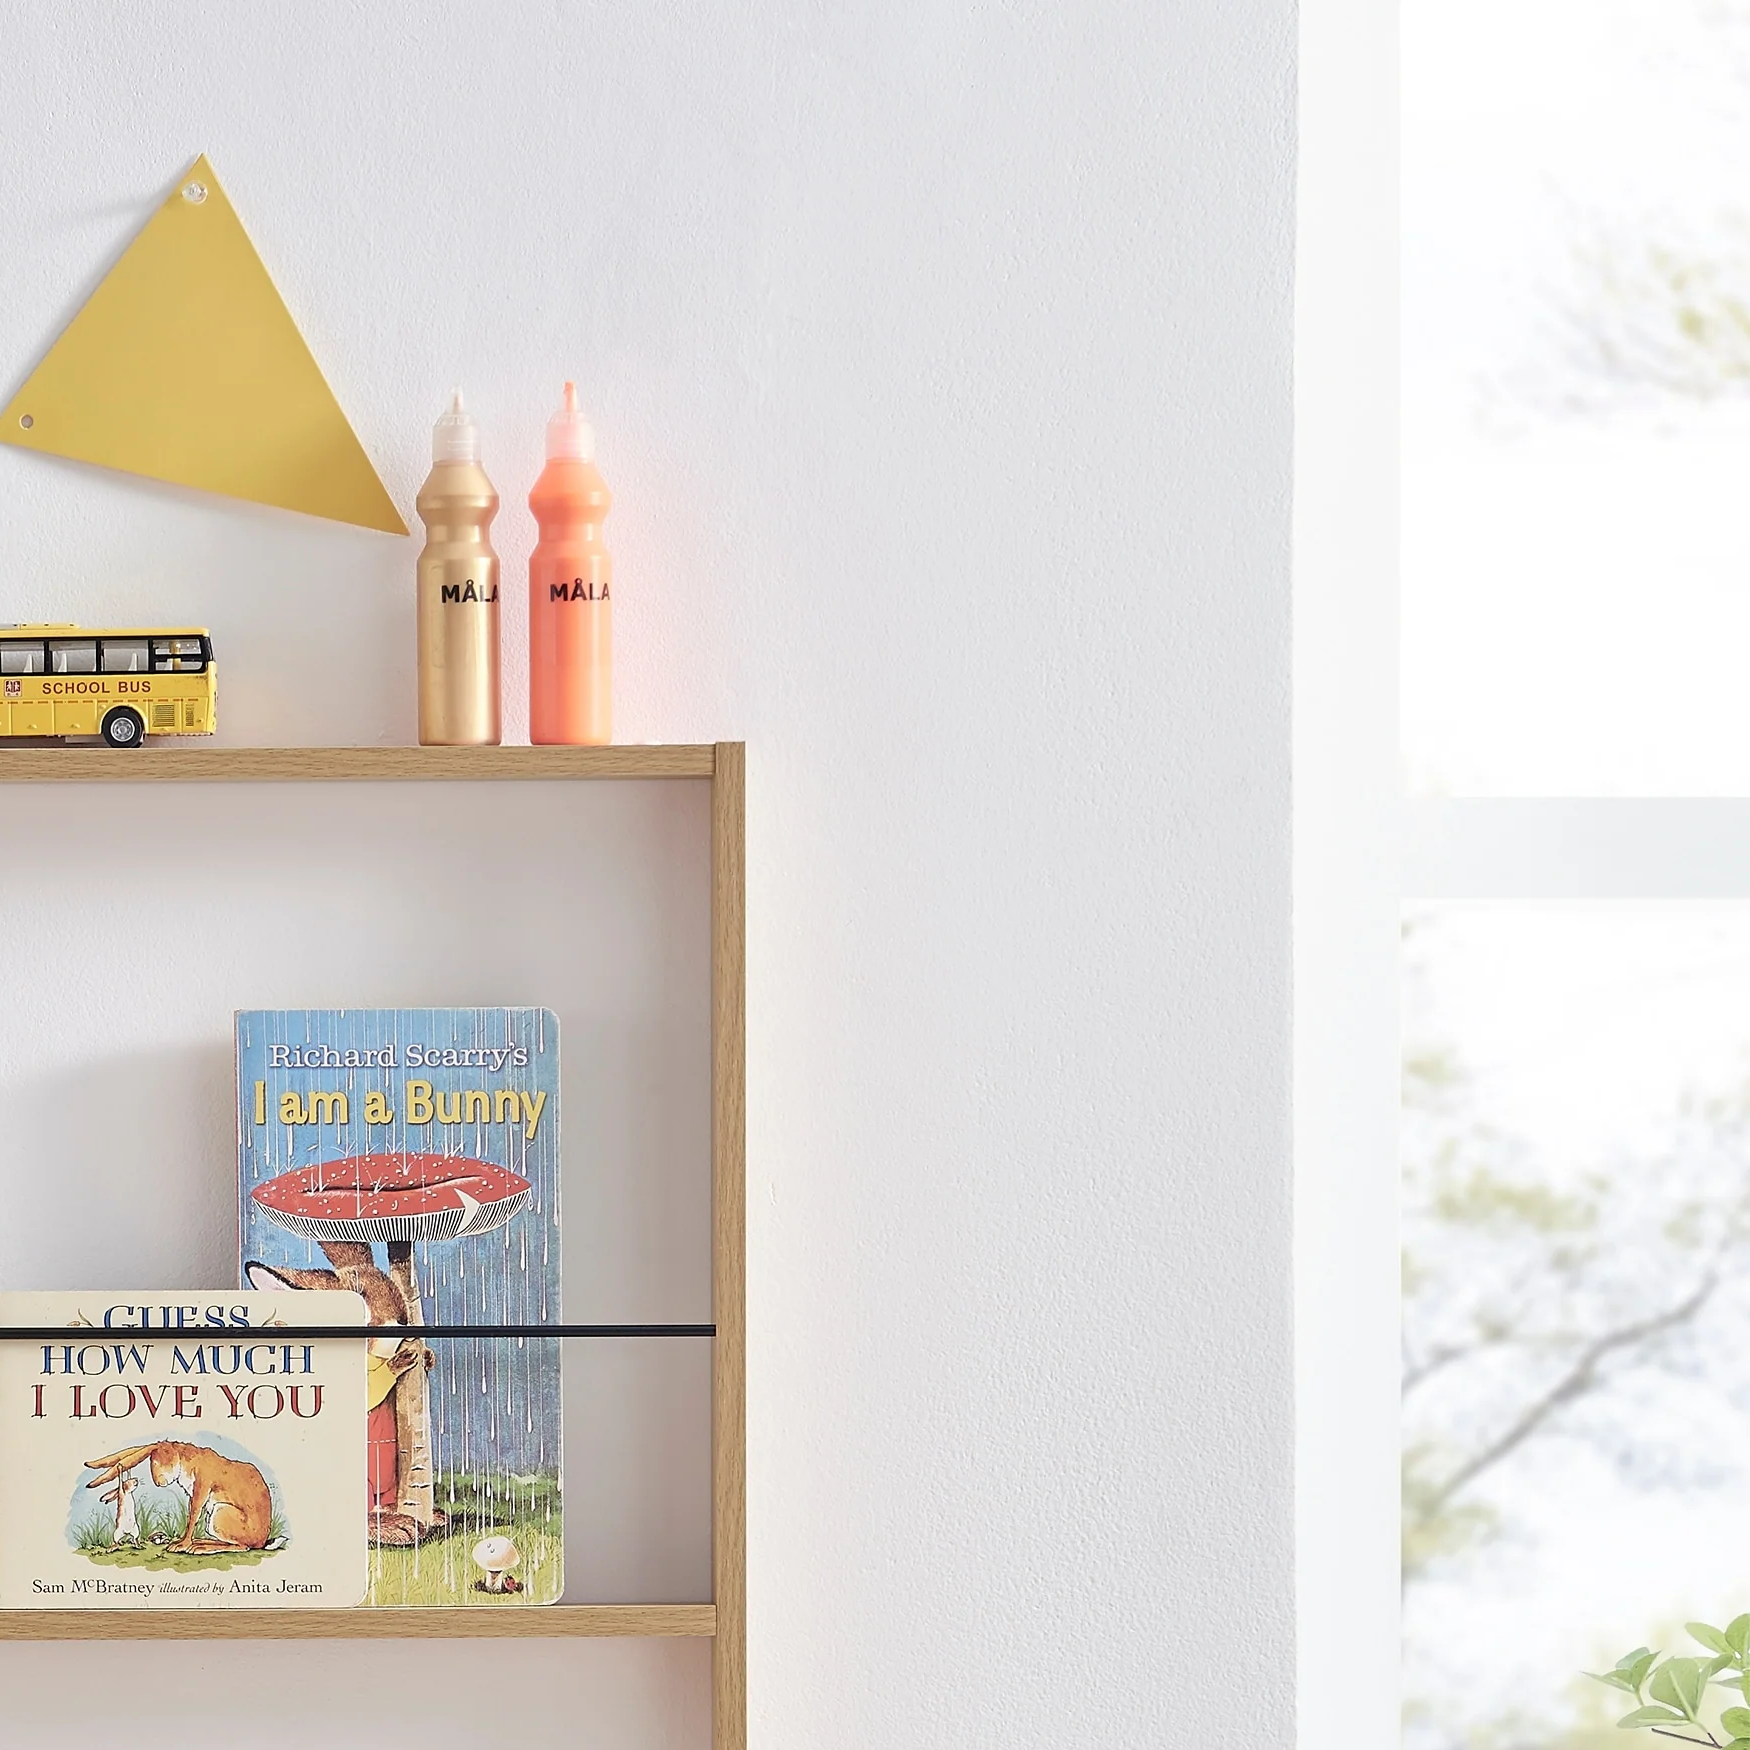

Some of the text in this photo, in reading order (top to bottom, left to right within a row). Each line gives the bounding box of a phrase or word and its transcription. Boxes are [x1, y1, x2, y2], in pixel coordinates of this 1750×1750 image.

[550, 577, 611, 602] MÅLA
[42, 681, 151, 694] SCHOOL BUS
[269, 1041, 529, 1072] Richard Scarry's
[254, 1080, 547, 1140] I am a Bunny
[103, 1305, 251, 1328] GUESS
[40, 1343, 315, 1376] HOW MUCH
[31, 1384, 325, 1421] I LOVE YOU
[32, 1579, 323, 1598] Sam McBratney illustrated by Anita Jeram
